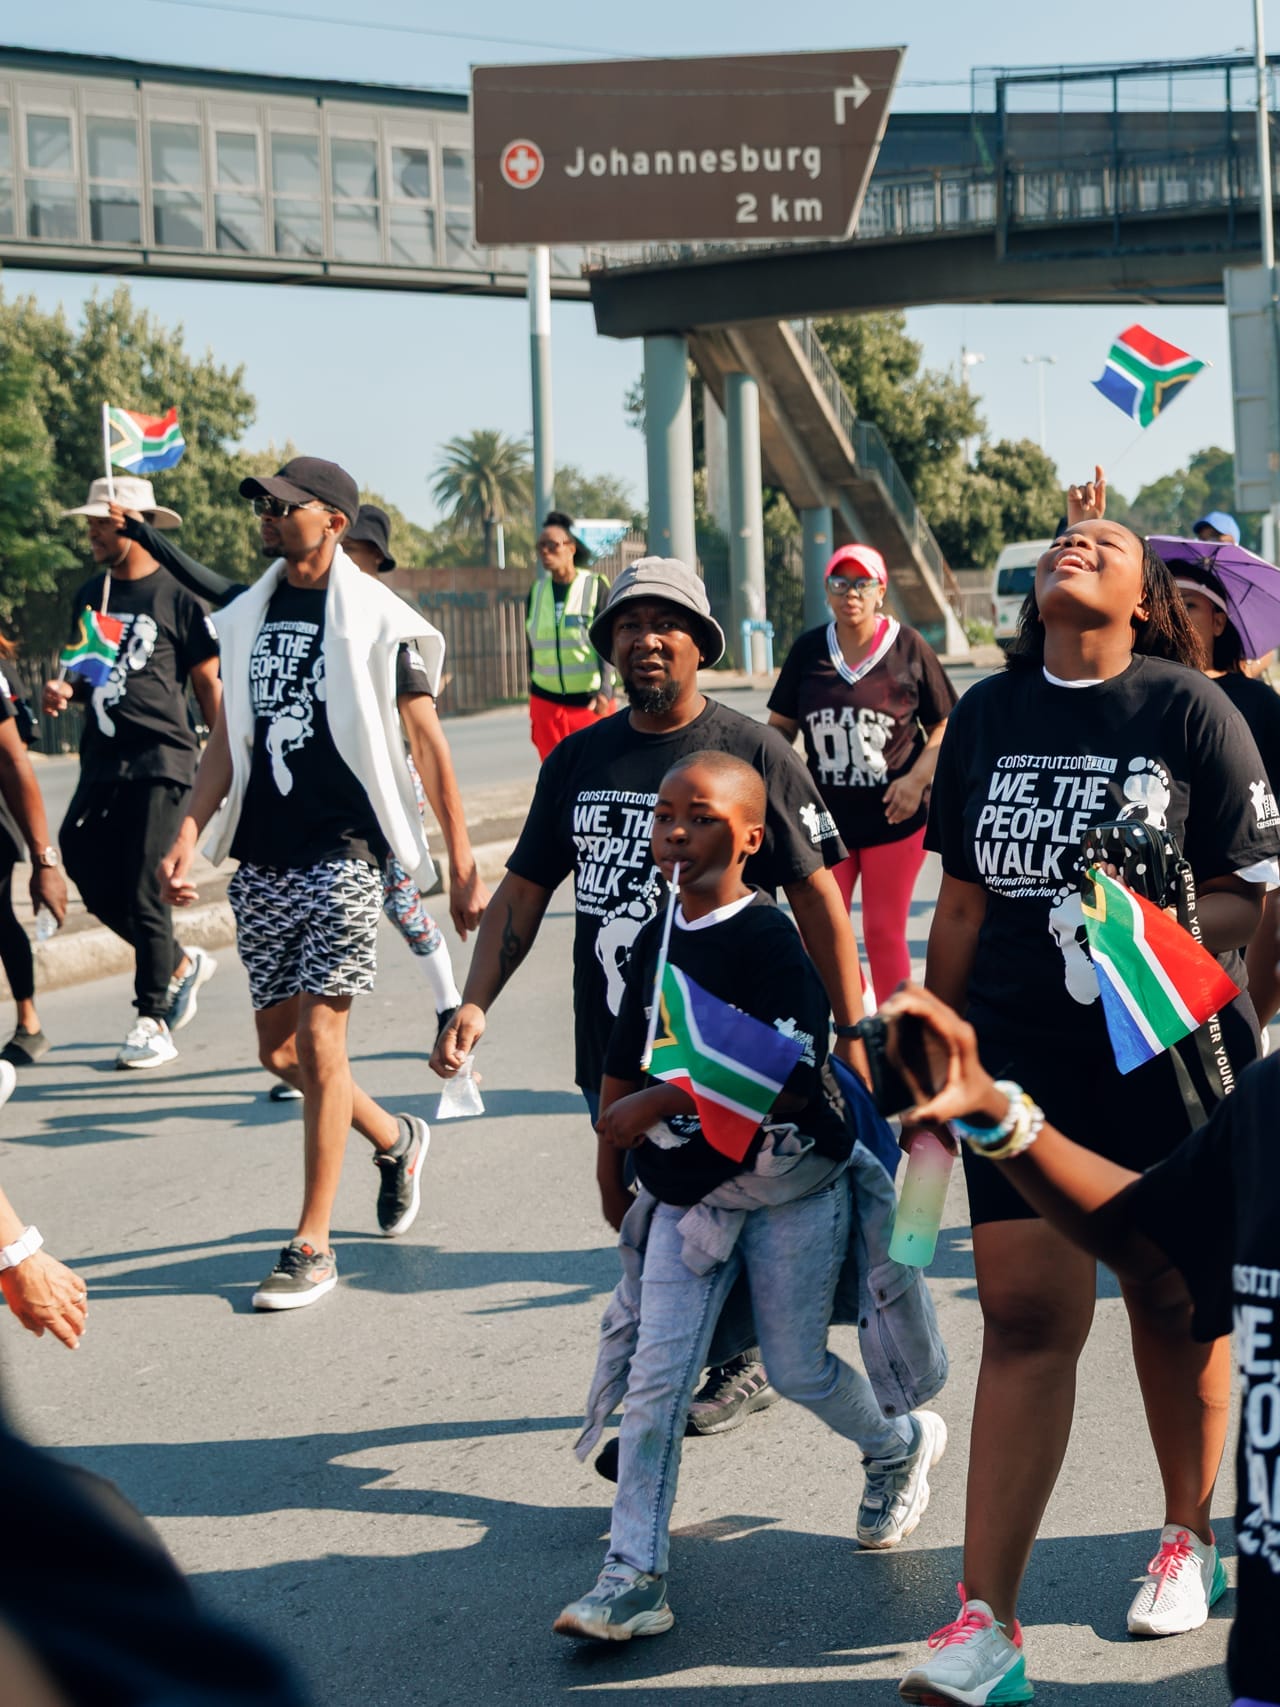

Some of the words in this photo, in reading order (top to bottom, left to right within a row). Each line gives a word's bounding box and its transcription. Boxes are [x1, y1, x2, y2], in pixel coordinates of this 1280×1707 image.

[565, 144, 821, 178] Johannesburg
[736, 194, 758, 223] 2
[771, 195, 823, 221] km
[277, 633, 313, 657] THE
[251, 655, 299, 681] EOPLE
[806, 707, 895, 738] TRACK
[818, 765, 888, 786] TEAM
[988, 771, 1040, 808] WE,
[1053, 775, 1110, 810] THE
[573, 805, 612, 837] WE,
[621, 807, 656, 839] TH
[975, 805, 1092, 845] PEOPLE
[974, 841, 1064, 880] WALK
[1214, 1047, 1235, 1095] YOUNG
